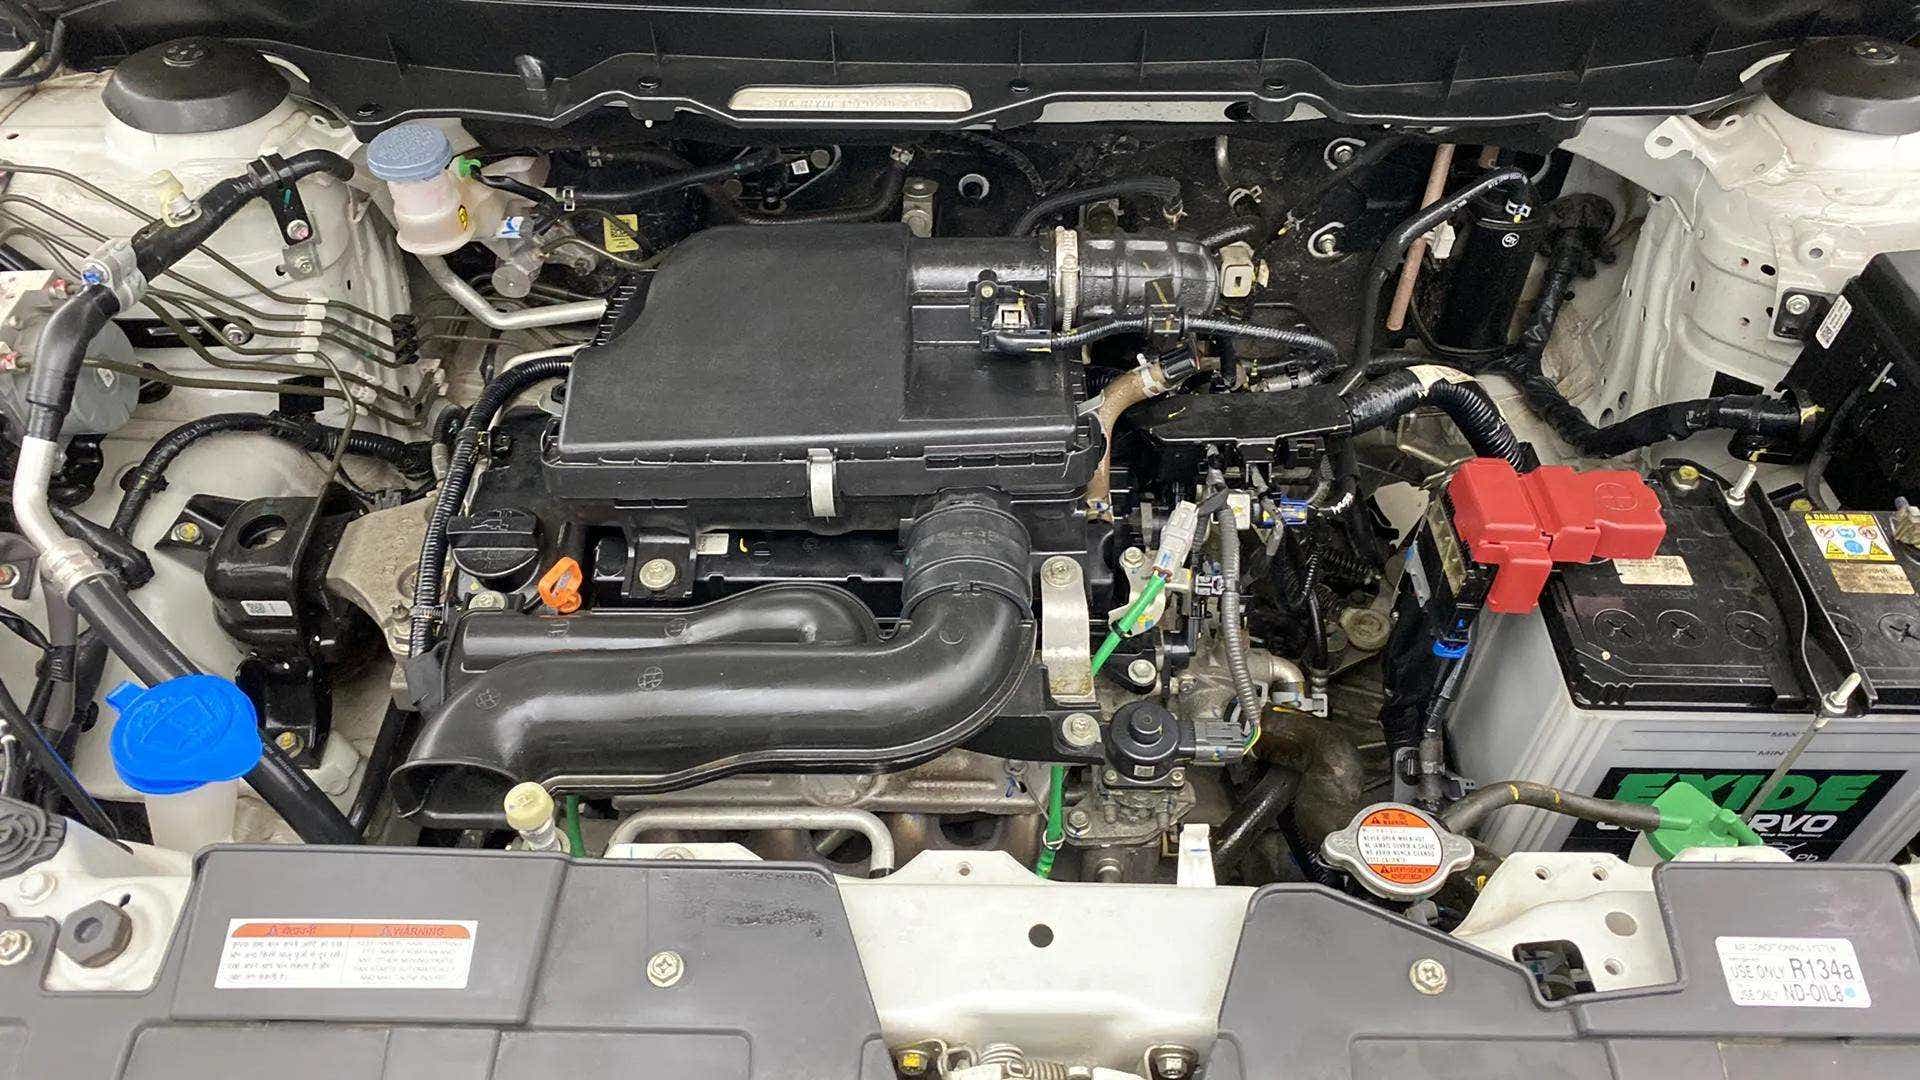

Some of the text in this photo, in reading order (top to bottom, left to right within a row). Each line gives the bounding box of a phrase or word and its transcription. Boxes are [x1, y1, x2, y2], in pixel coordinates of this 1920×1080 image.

[1614, 773, 1881, 812] EXIDE
[394, 926, 445, 937] WARNING
[1730, 958, 1854, 980] USE ONLY R134a
[1783, 983, 1844, 1002] ND-OIL8
